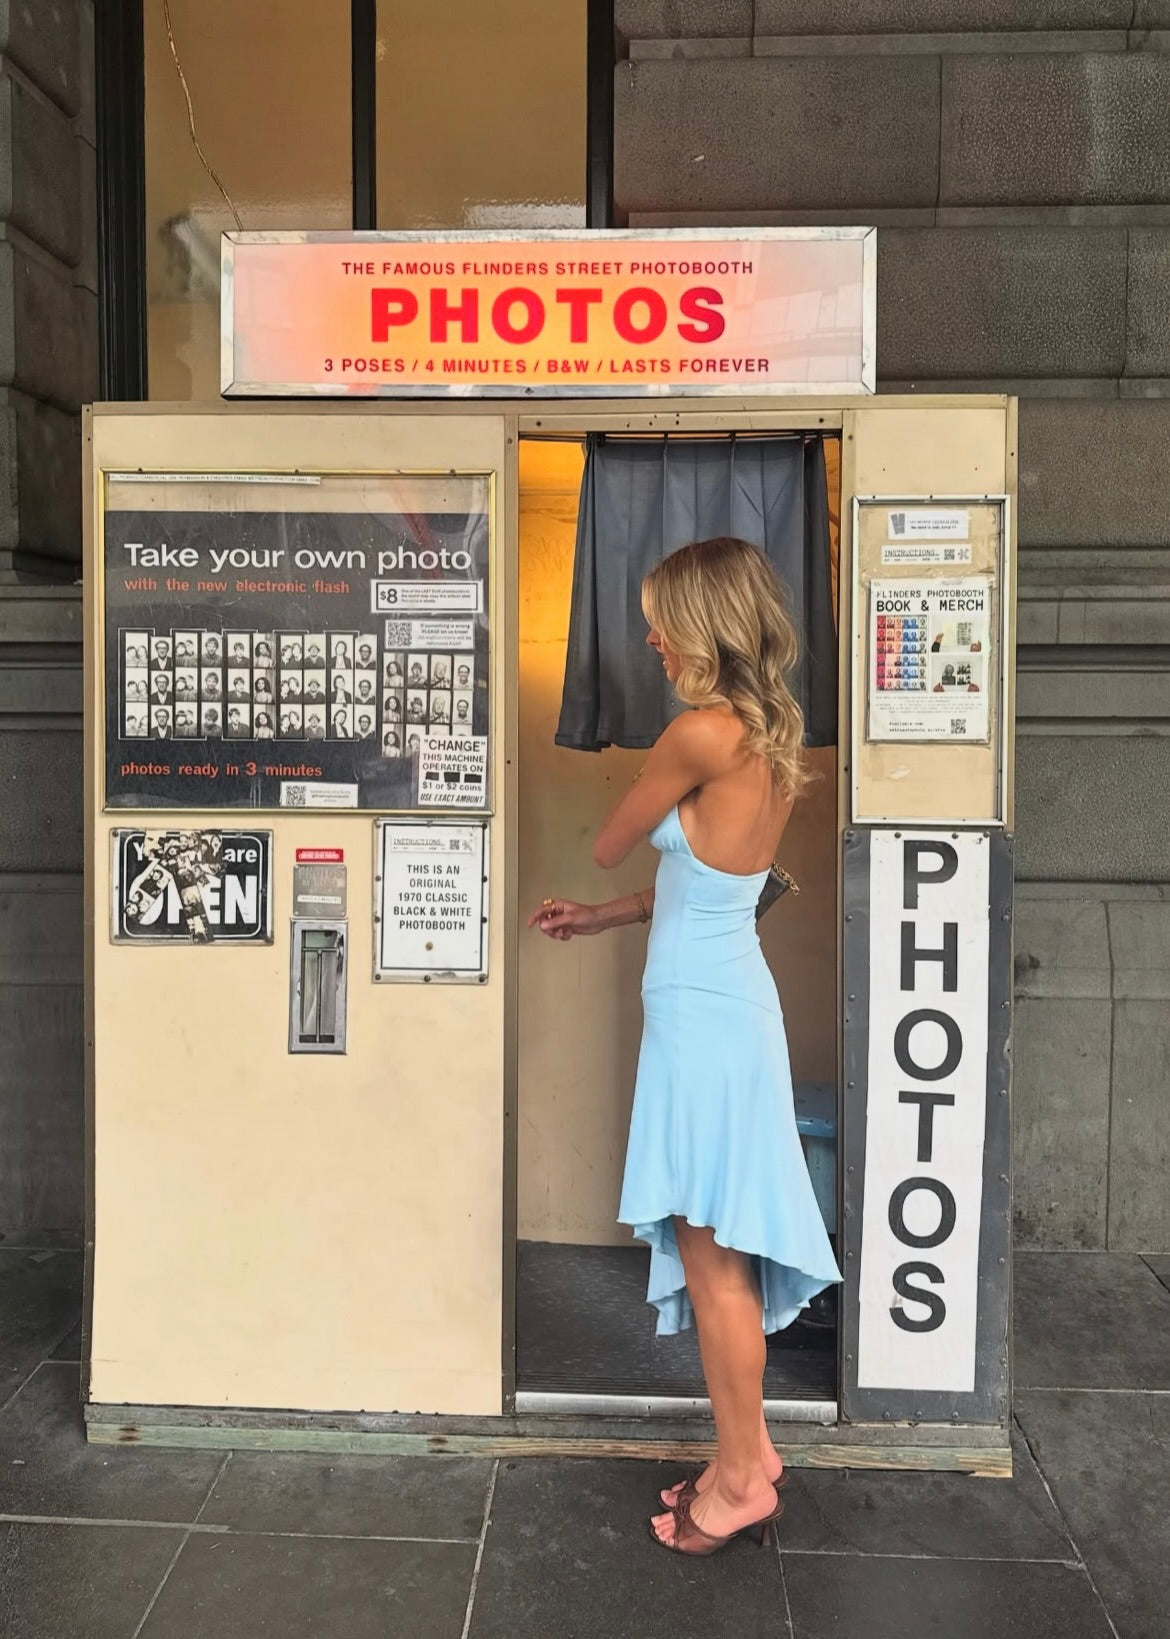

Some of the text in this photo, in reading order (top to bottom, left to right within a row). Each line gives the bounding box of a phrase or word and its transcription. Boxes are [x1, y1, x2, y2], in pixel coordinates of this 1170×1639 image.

[342, 261, 754, 275] THE FAMOUS FLINDERS STREET PHOTOBOOTH
[370, 286, 727, 345] PHOTOS
[324, 359, 771, 374] 3 POSES / 4 MINUTES / B&W / LASTS FOREVER
[124, 543, 472, 575] Take your own photo
[124, 578, 350, 594] with the new electronic flash
[380, 588, 398, 604] $8
[927, 589, 984, 598] PHOTOBOOTH
[876, 599, 984, 612] BOOK & MERCH
[424, 738, 486, 752] "CHANGE"
[423, 753, 484, 763] THIS MACHINE
[121, 762, 322, 779] photos ready in 3 minutes
[422, 763, 468, 772] OPERATES
[422, 781, 432, 789] $1
[421, 793, 484, 803] USE EXACT AMOUNT
[224, 848, 257, 863] are
[407, 864, 460, 875] THIS IS AN
[409, 878, 457, 889] ORIGINAL
[398, 892, 468, 903] 1970 CLASSIC
[393, 906, 472, 917] BLACK & WHITE
[399, 920, 465, 930] PHOTOBOOTH
[888, 839, 963, 1333] PHOTOS
